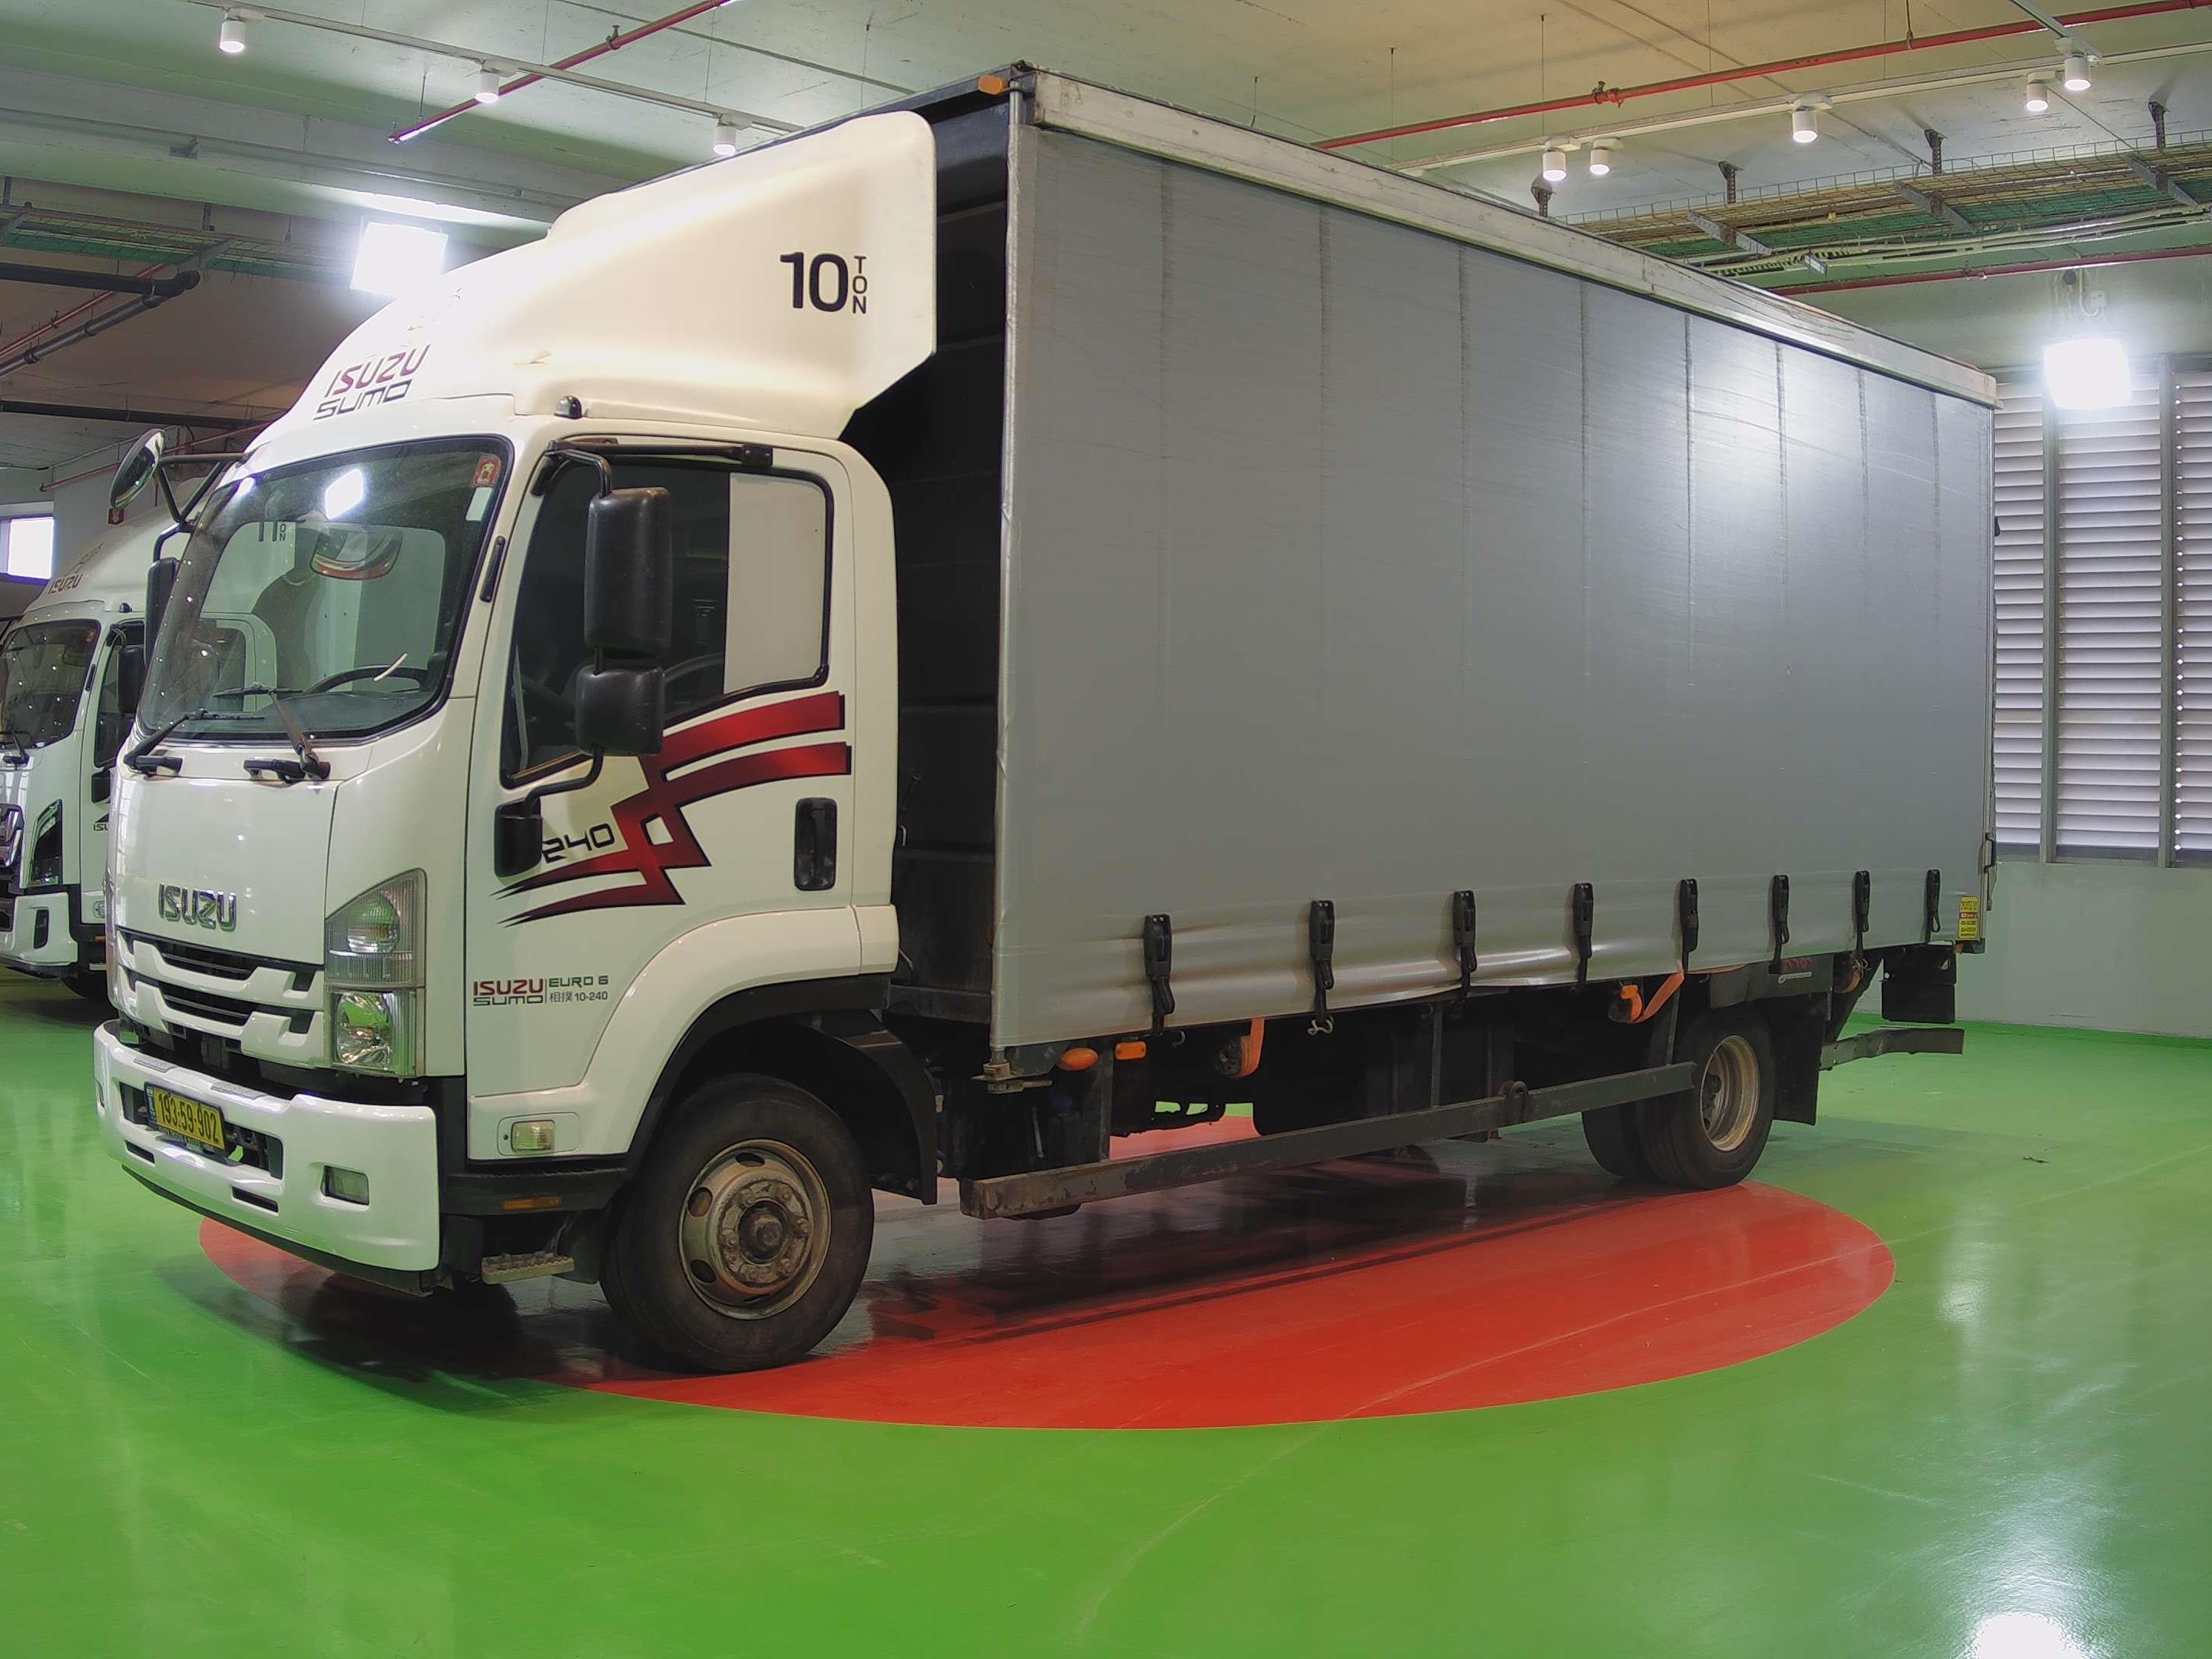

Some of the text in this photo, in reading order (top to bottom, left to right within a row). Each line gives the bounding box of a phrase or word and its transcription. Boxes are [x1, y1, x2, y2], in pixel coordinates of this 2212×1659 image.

[780, 251, 867, 314] 10 TON
[324, 343, 431, 398] ISUZU
[313, 379, 412, 421] SUMO
[48, 574, 84, 594] ISUZU
[541, 823, 615, 863] 240
[158, 883, 237, 932] ISUZU
[473, 978, 544, 996] ISUZU
[548, 975, 609, 988] EURO 6
[574, 991, 608, 1002] 10-240
[473, 995, 544, 1006] SUMO
